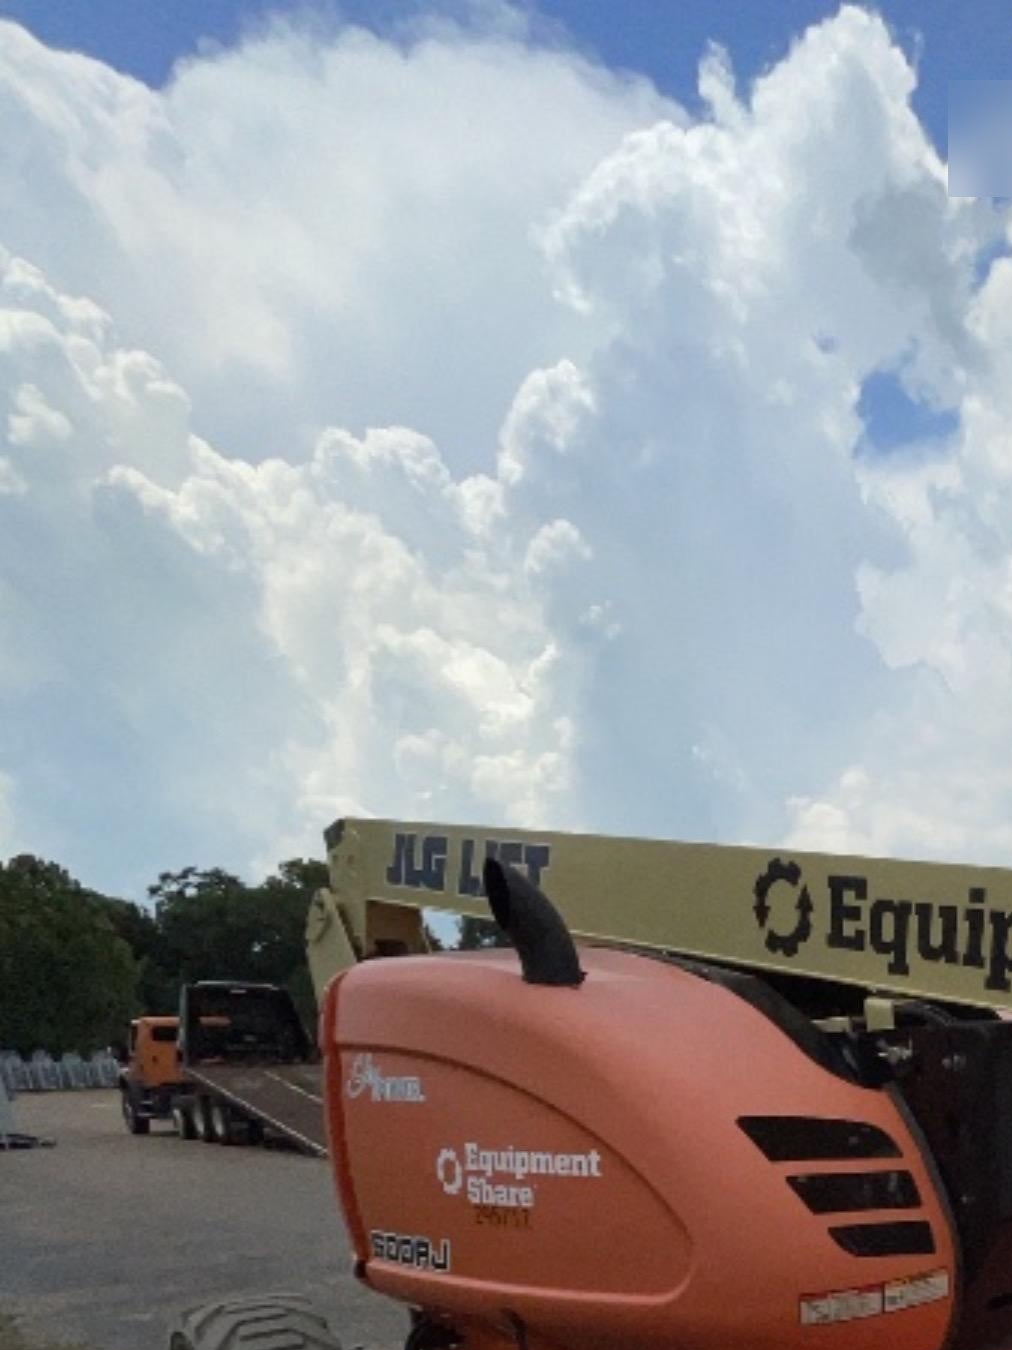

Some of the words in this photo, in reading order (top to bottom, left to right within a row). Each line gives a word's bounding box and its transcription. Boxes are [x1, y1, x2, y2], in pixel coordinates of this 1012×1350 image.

[385, 832, 448, 892] JLG
[463, 1142, 603, 1180] Equipment
[466, 1175, 535, 1208] Share
